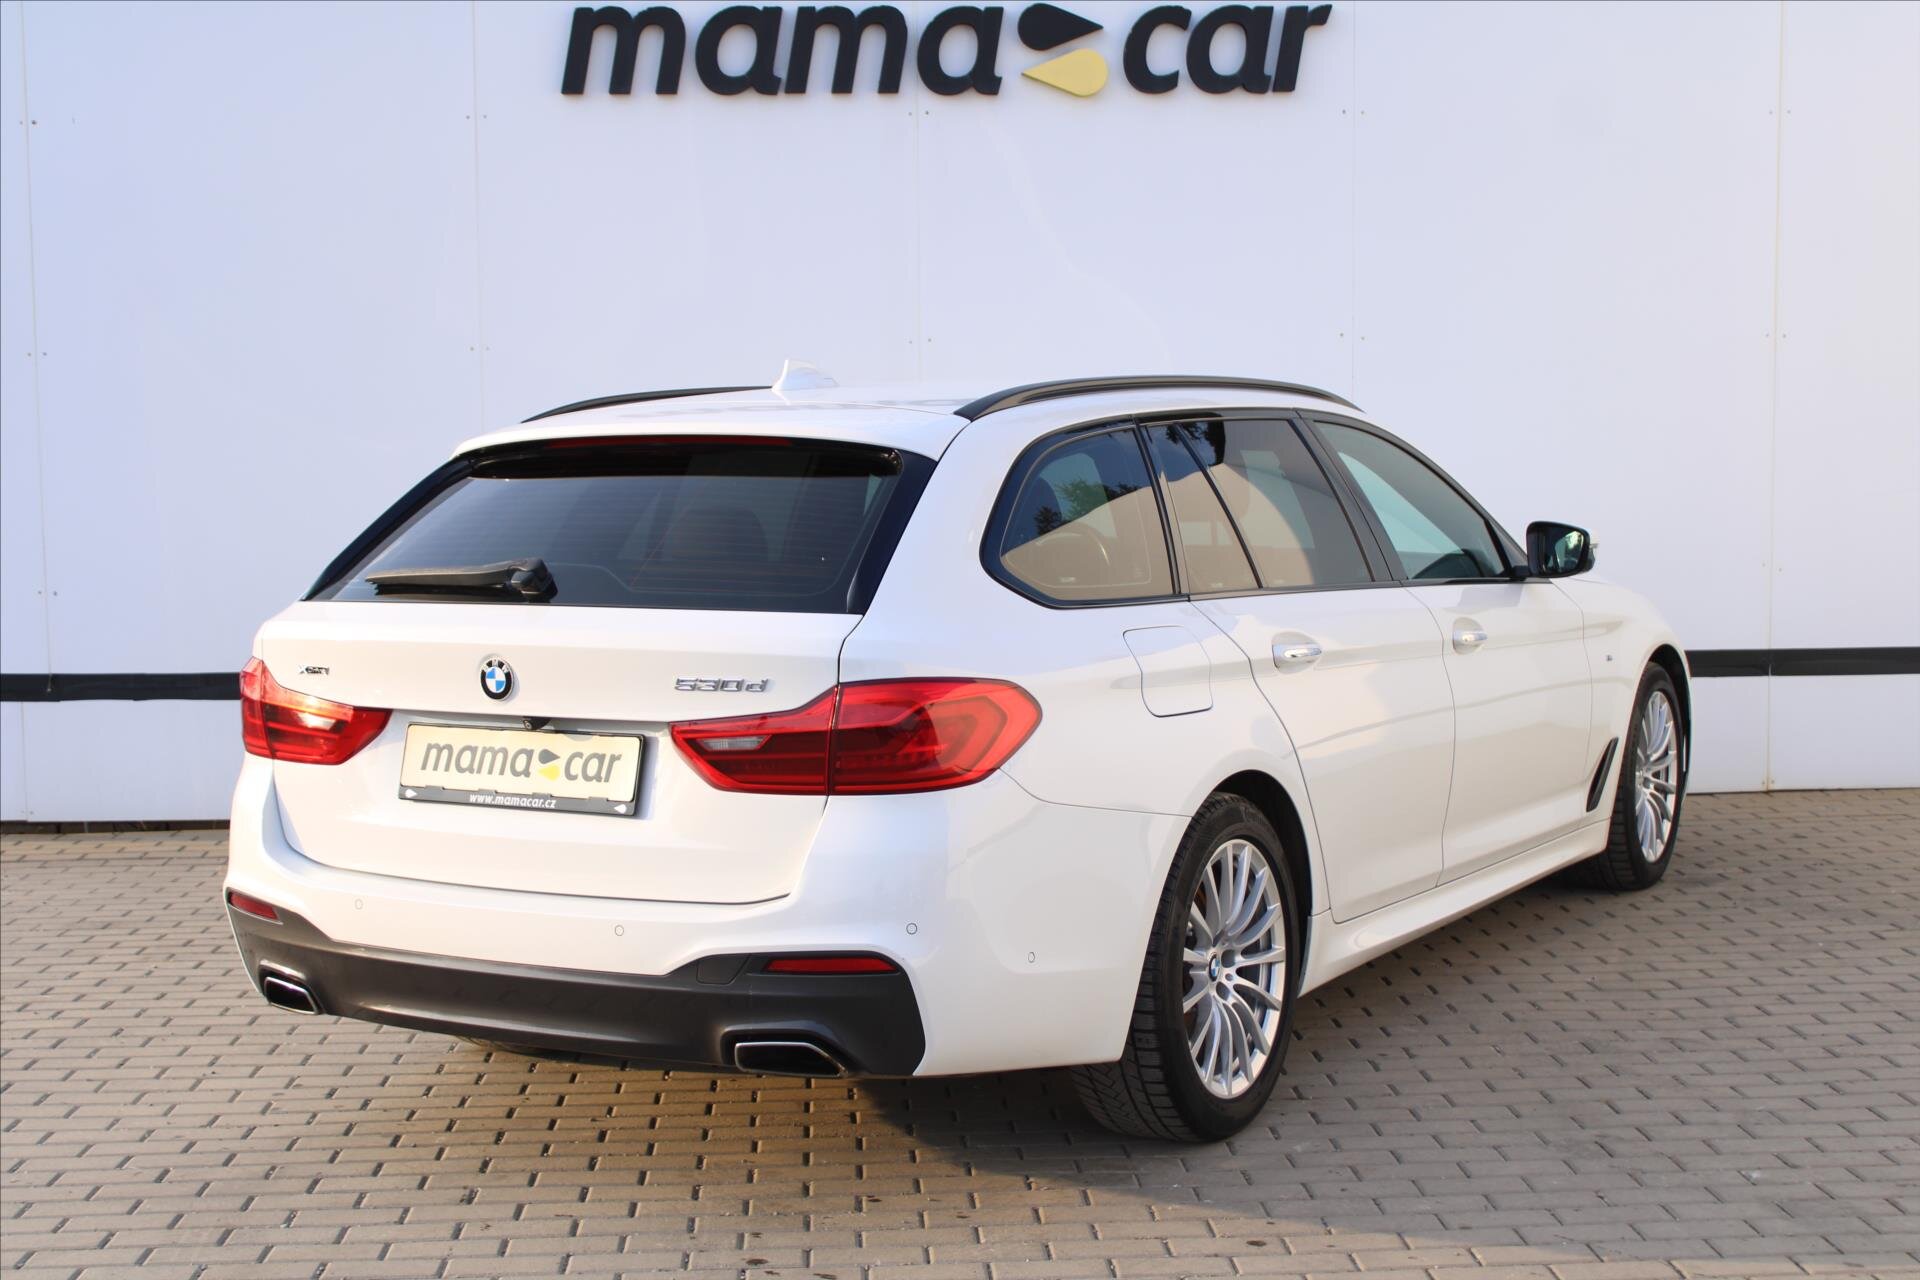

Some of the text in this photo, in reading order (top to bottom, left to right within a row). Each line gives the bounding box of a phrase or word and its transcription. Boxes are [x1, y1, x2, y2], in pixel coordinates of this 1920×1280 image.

[561, 4, 1333, 96] mama car
[674, 678, 769, 692] 530d
[420, 742, 622, 783] mama car
[469, 793, 557, 809] www.mamacar.cz
